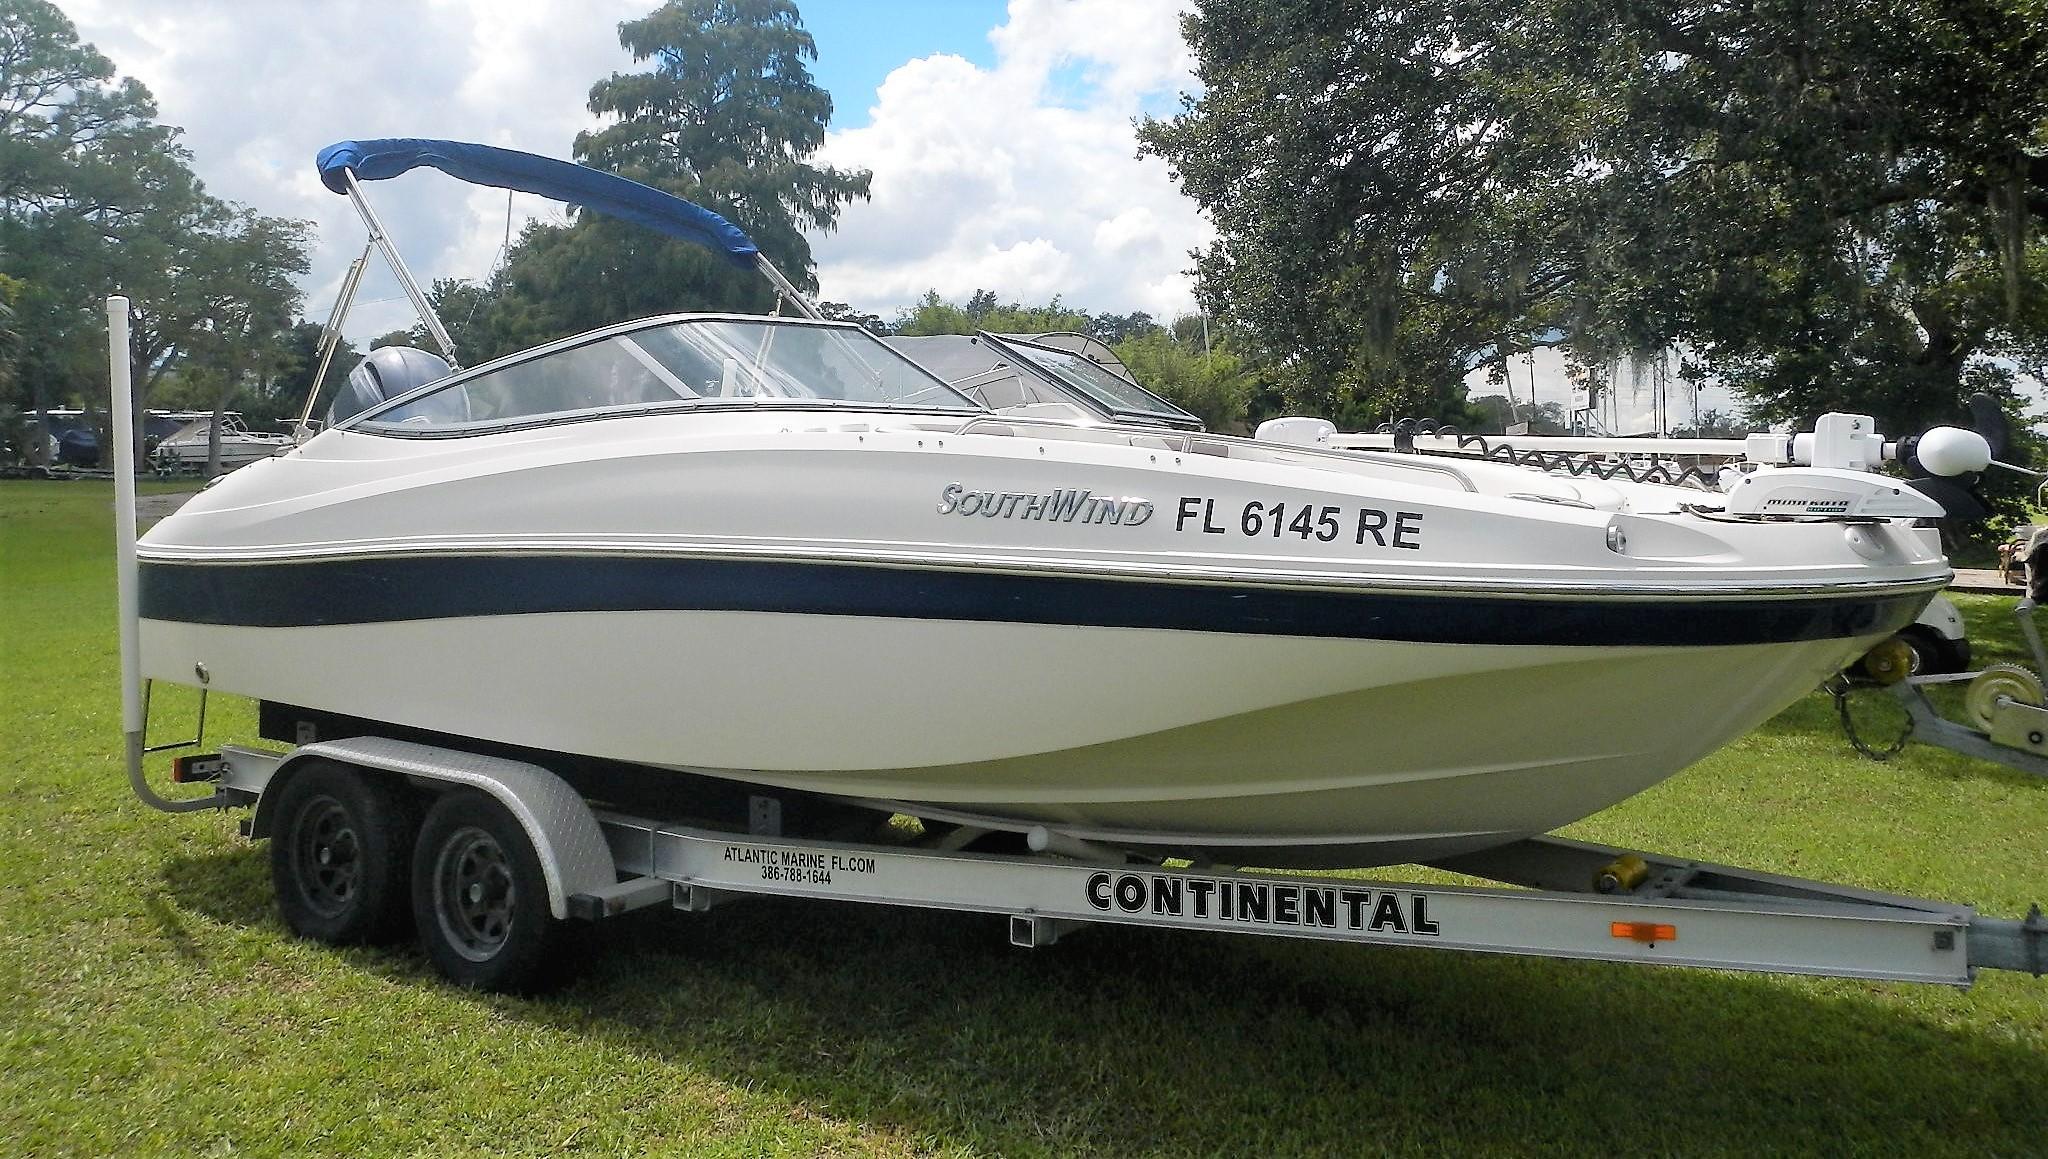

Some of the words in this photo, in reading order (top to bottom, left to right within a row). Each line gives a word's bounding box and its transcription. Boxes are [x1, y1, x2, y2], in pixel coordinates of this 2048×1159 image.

[1175, 496, 1226, 535] FL
[1240, 500, 1341, 543] 6145
[1355, 508, 1425, 551] RE
[724, 846, 778, 866] ATLANTIC
[781, 851, 826, 870] MARINE
[831, 855, 875, 874] FL.COM
[761, 865, 832, 885] 386-788-1644
[1085, 871, 1440, 936] CONTINENTAL
